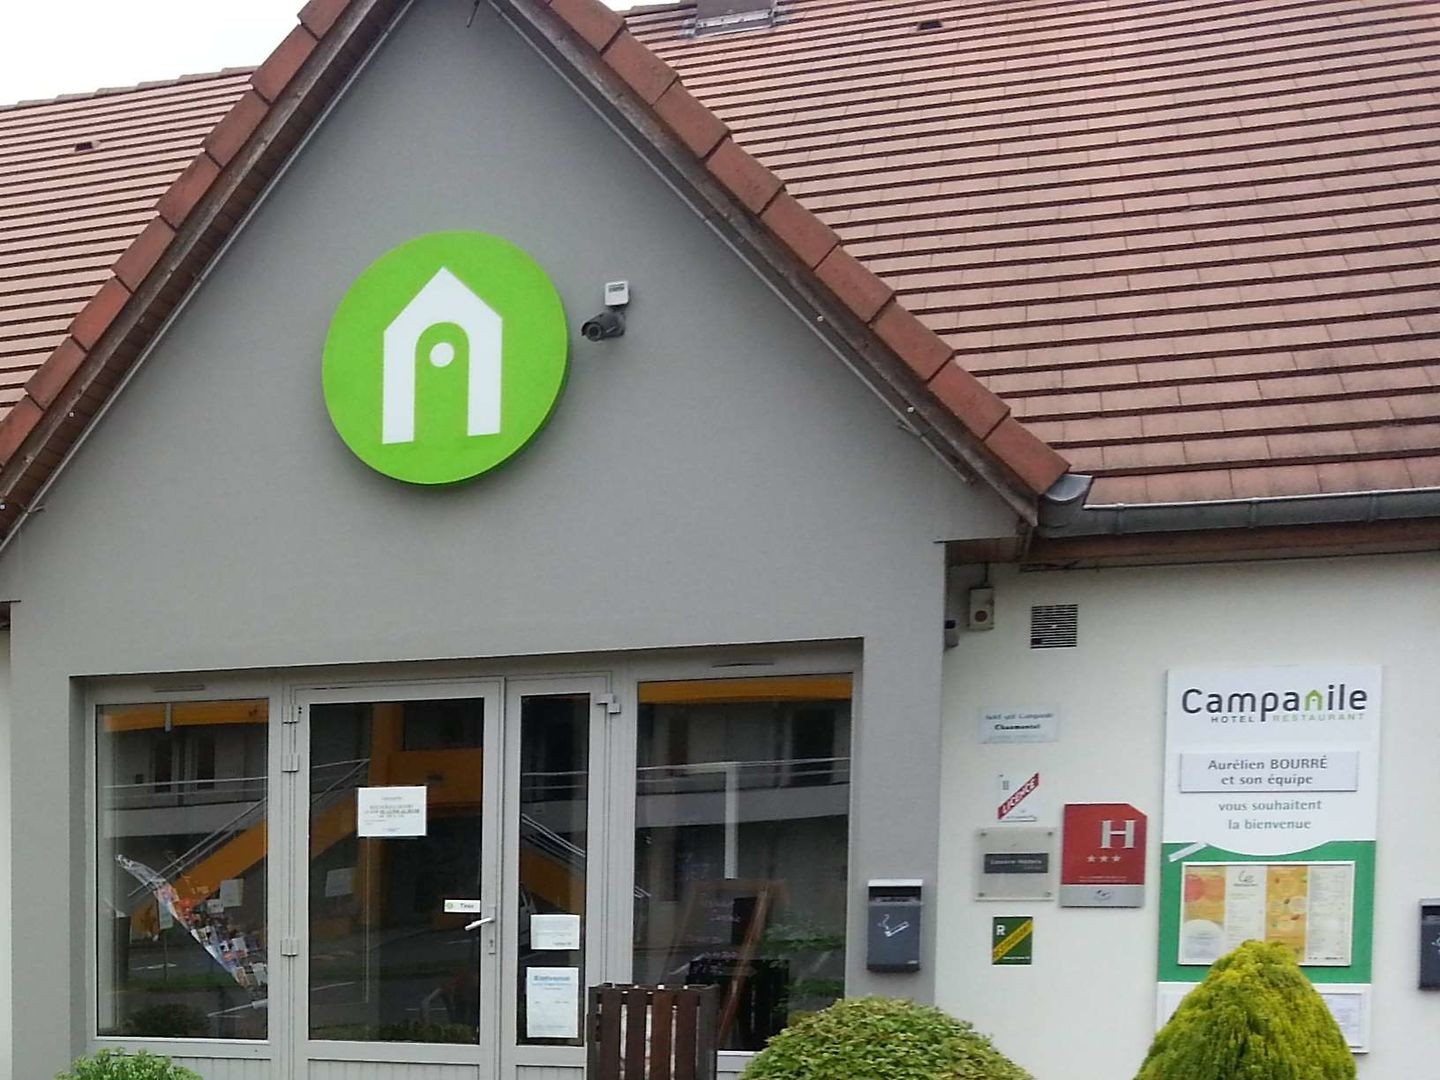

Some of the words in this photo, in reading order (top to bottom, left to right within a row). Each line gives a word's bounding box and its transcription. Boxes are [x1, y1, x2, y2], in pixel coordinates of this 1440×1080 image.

[1181, 683, 1368, 722] Campanile
[1210, 715, 1256, 724] HOTEL
[1272, 713, 1365, 722] RESTAURANT
[1207, 759, 1265, 771] Aurélien
[1270, 755, 1328, 770] BOURRÉ
[1220, 775, 1235, 786] et
[1239, 776, 1263, 785] son
[1267, 773, 1314, 787] équipe
[1218, 802, 1248, 812] vous
[1251, 799, 1322, 811] souhaitent
[1228, 819, 1240, 830] la
[1244, 818, 1312, 830] bienvenue
[1097, 820, 1137, 849] H
[995, 924, 1006, 936] R
